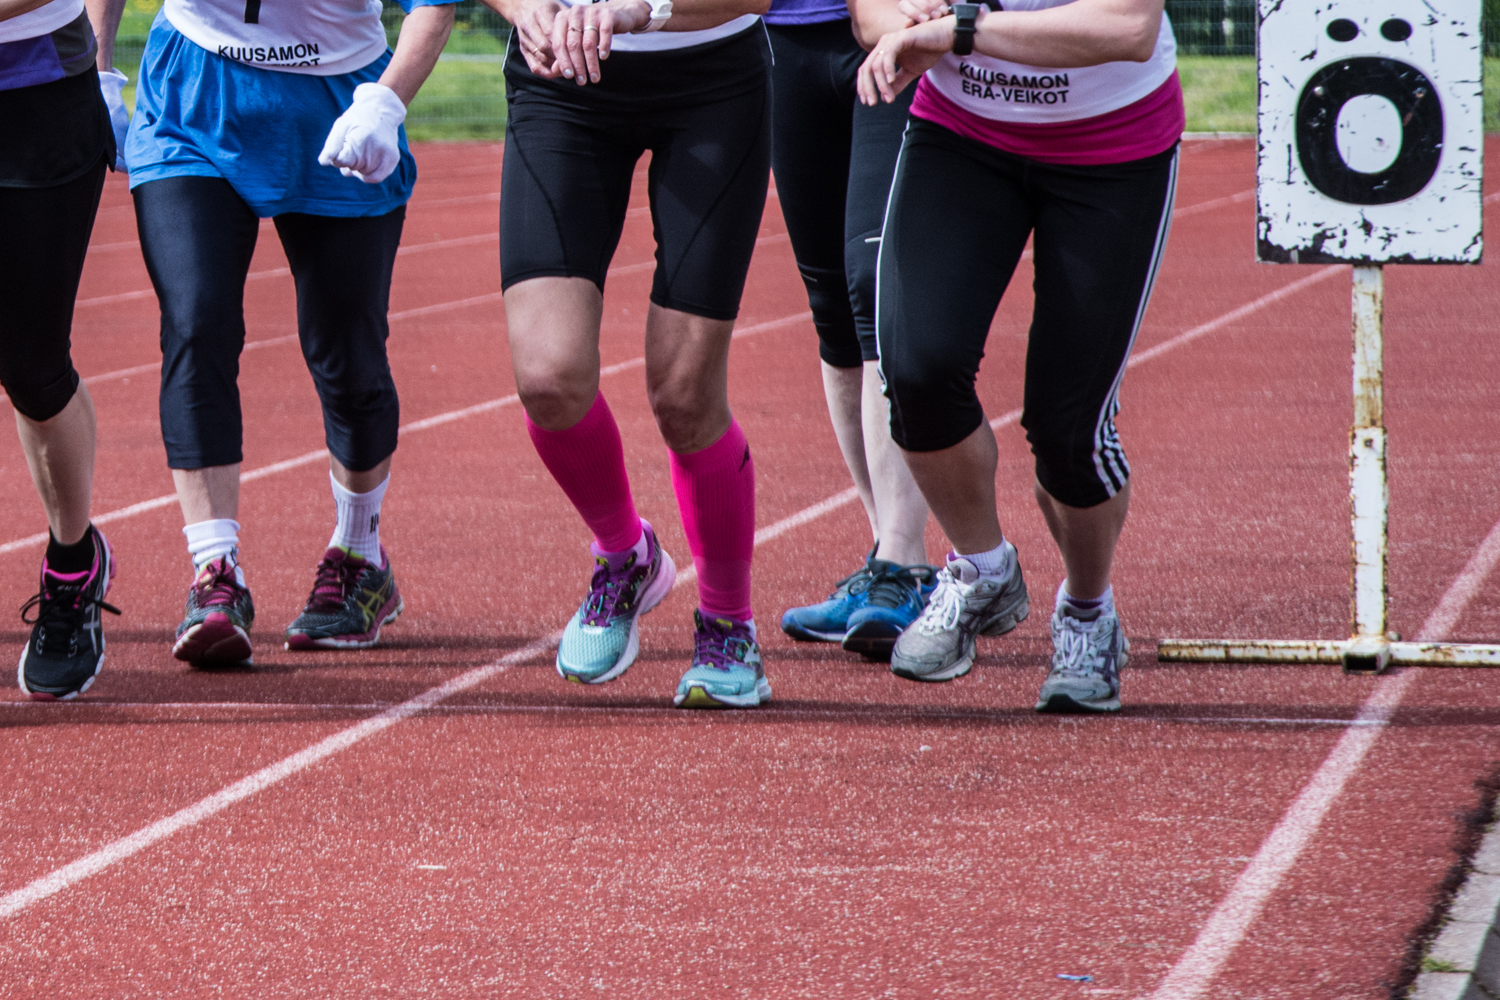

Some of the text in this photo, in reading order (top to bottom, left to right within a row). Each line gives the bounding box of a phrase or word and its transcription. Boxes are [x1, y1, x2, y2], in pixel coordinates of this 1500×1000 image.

[217, 43, 319, 62] KUUSAMON
[959, 61, 1069, 89] KUUSAMON
[962, 79, 1070, 105] ERÄ-VEIKOT
